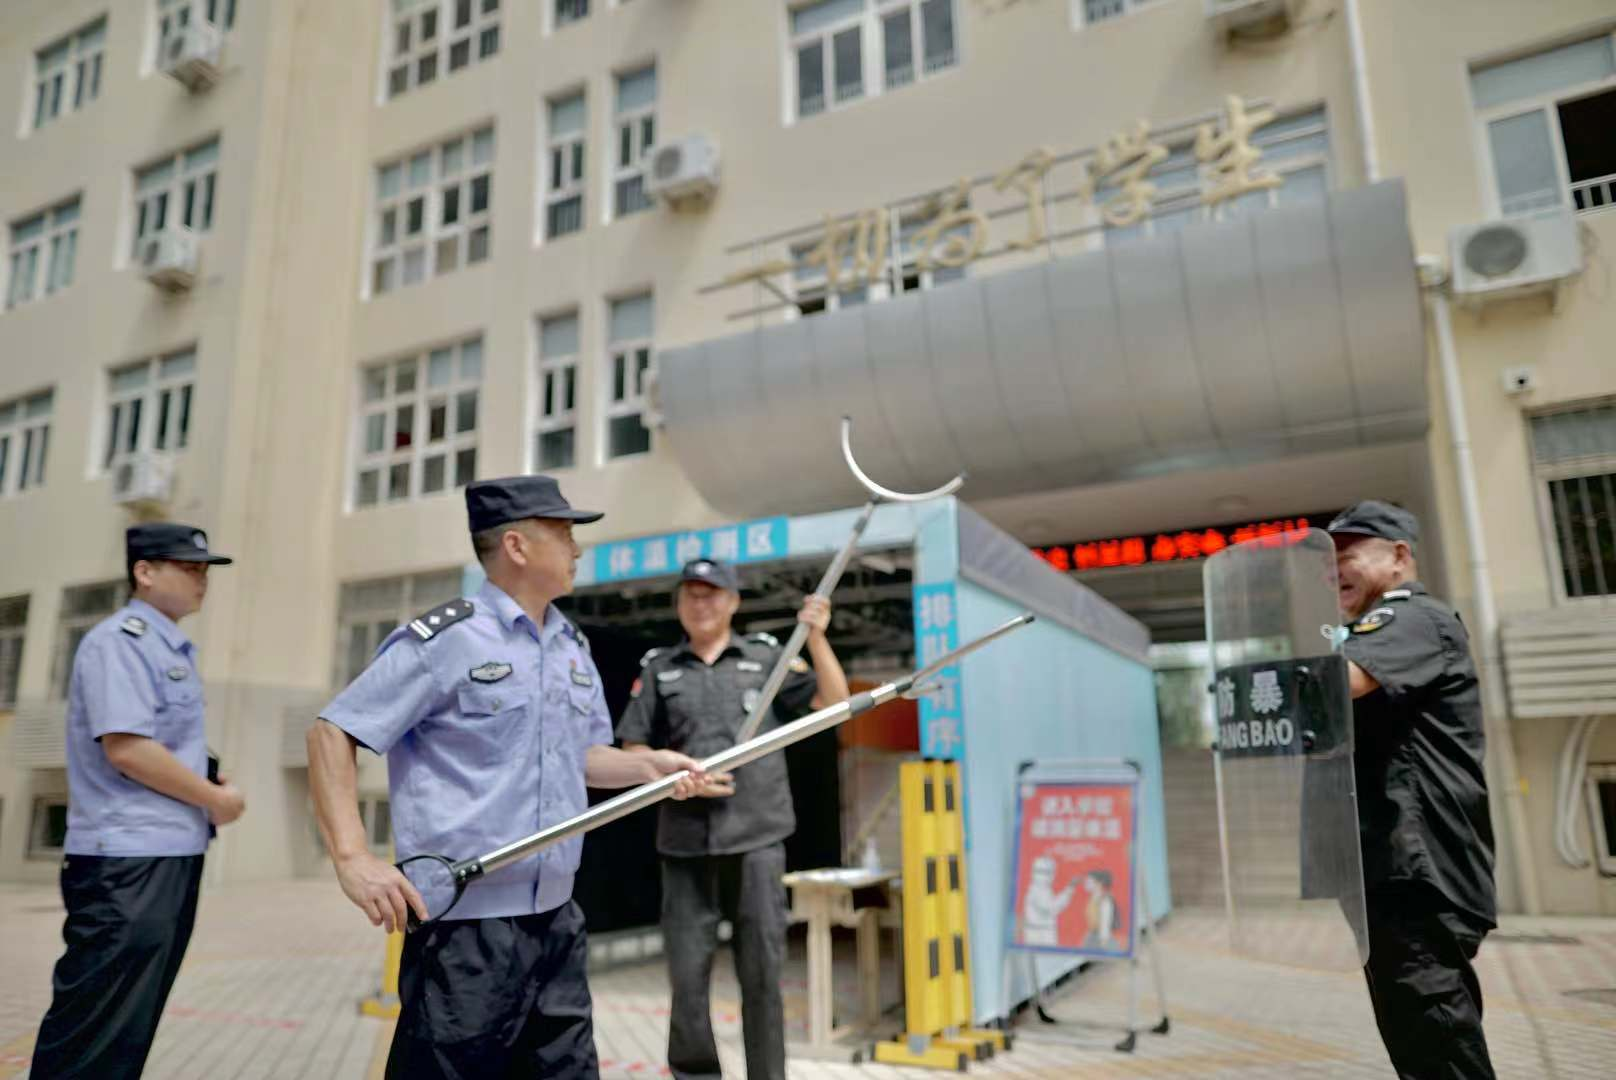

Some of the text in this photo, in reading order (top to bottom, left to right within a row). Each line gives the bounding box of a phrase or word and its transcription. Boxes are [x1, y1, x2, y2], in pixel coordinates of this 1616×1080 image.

[609, 521, 773, 577] 体温检测区
